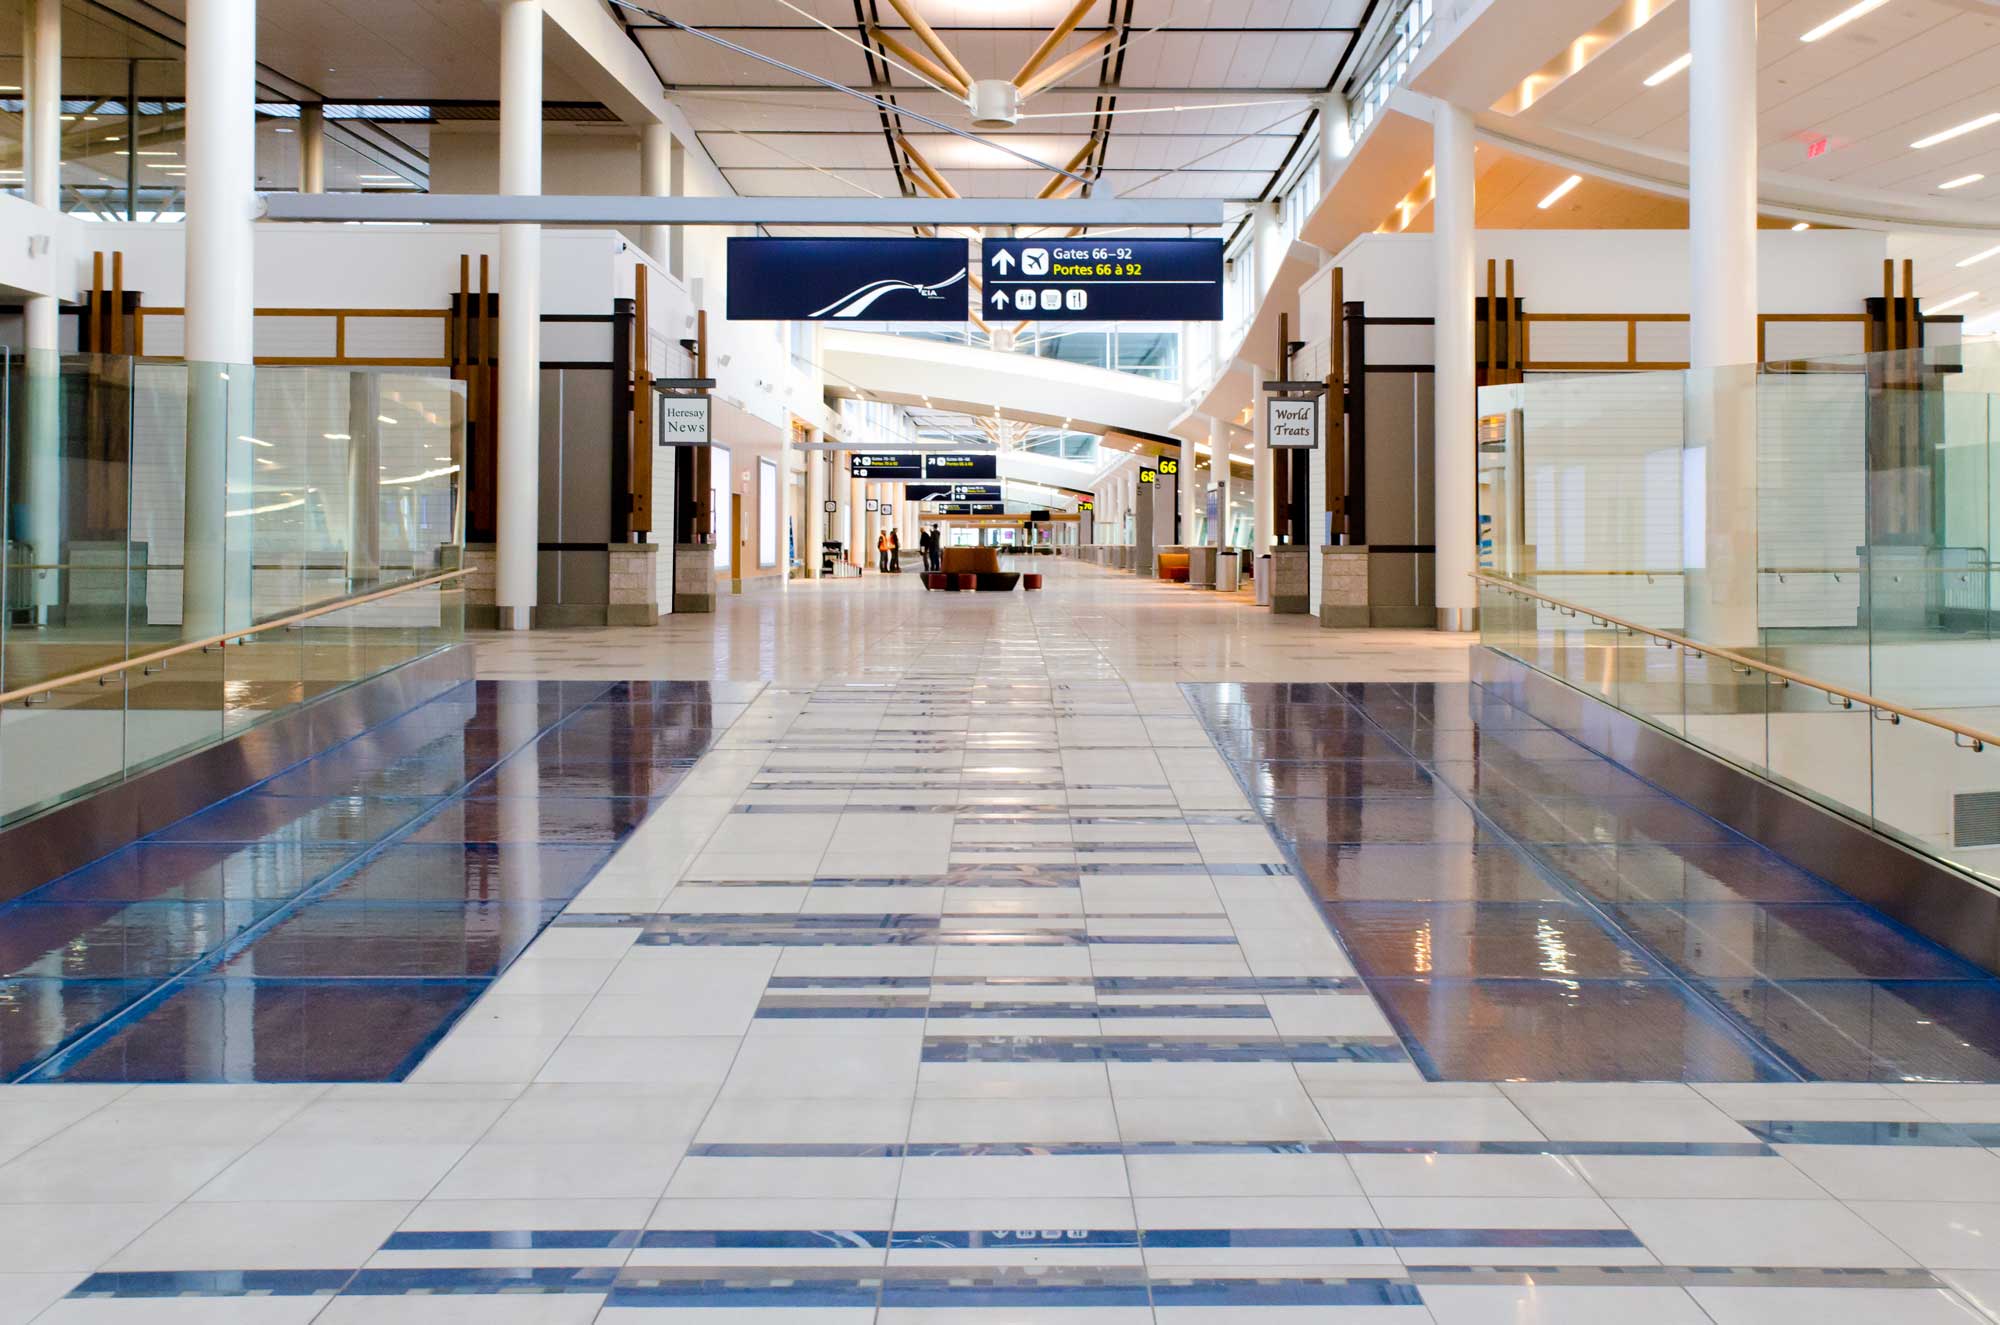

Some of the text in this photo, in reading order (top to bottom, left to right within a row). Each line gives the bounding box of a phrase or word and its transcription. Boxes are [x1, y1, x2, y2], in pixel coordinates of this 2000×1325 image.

[1053, 248, 1089, 260] Gates
[1053, 263, 1142, 275] Portes 66 à 92
[667, 408, 705, 419] Heresay
[1275, 407, 1311, 420] World
[668, 421, 705, 432] News
[1273, 423, 1310, 436] Treats
[1159, 461, 1177, 474] 66
[1141, 470, 1156, 482] 68
